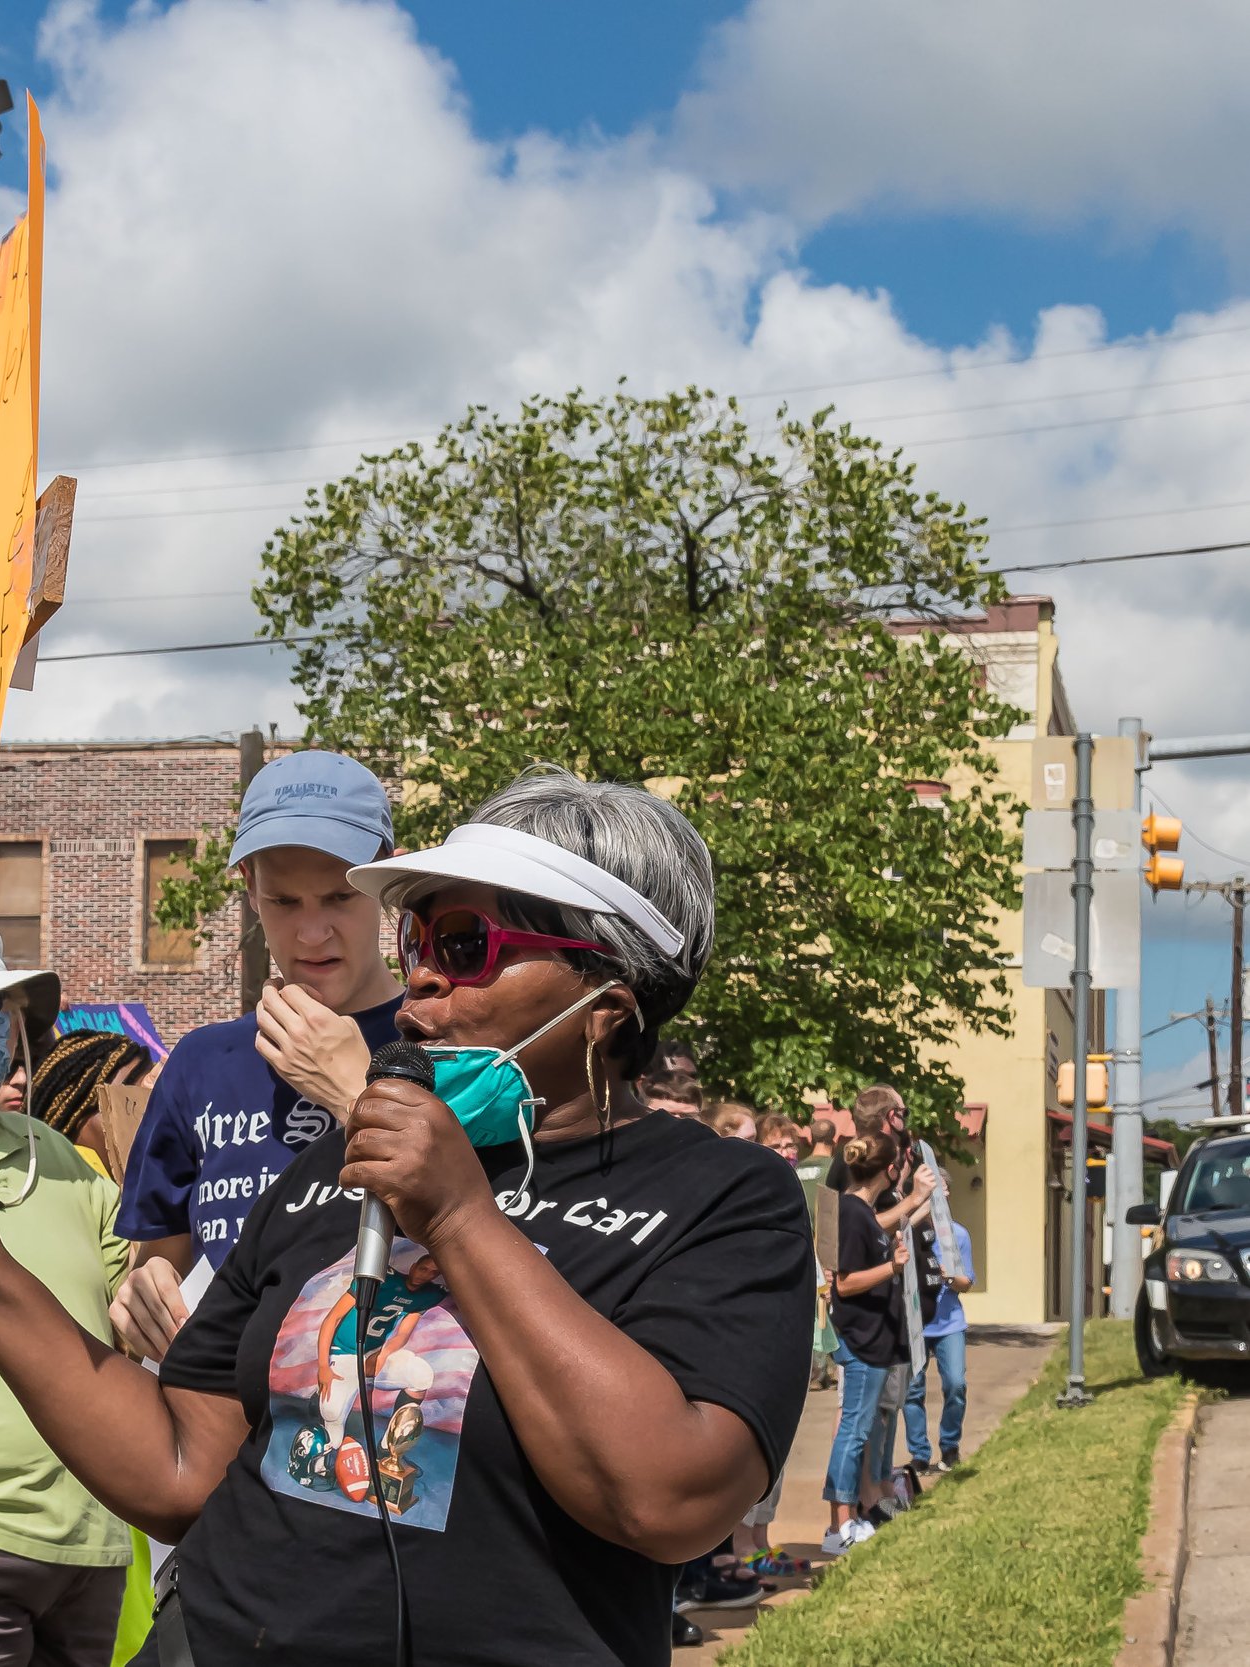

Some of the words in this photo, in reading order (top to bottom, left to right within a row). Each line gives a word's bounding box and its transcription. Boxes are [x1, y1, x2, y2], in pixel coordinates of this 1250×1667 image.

[199, 1175, 253, 1205] more
[197, 1217, 227, 1243] an
[563, 1197, 668, 1246] Carl
